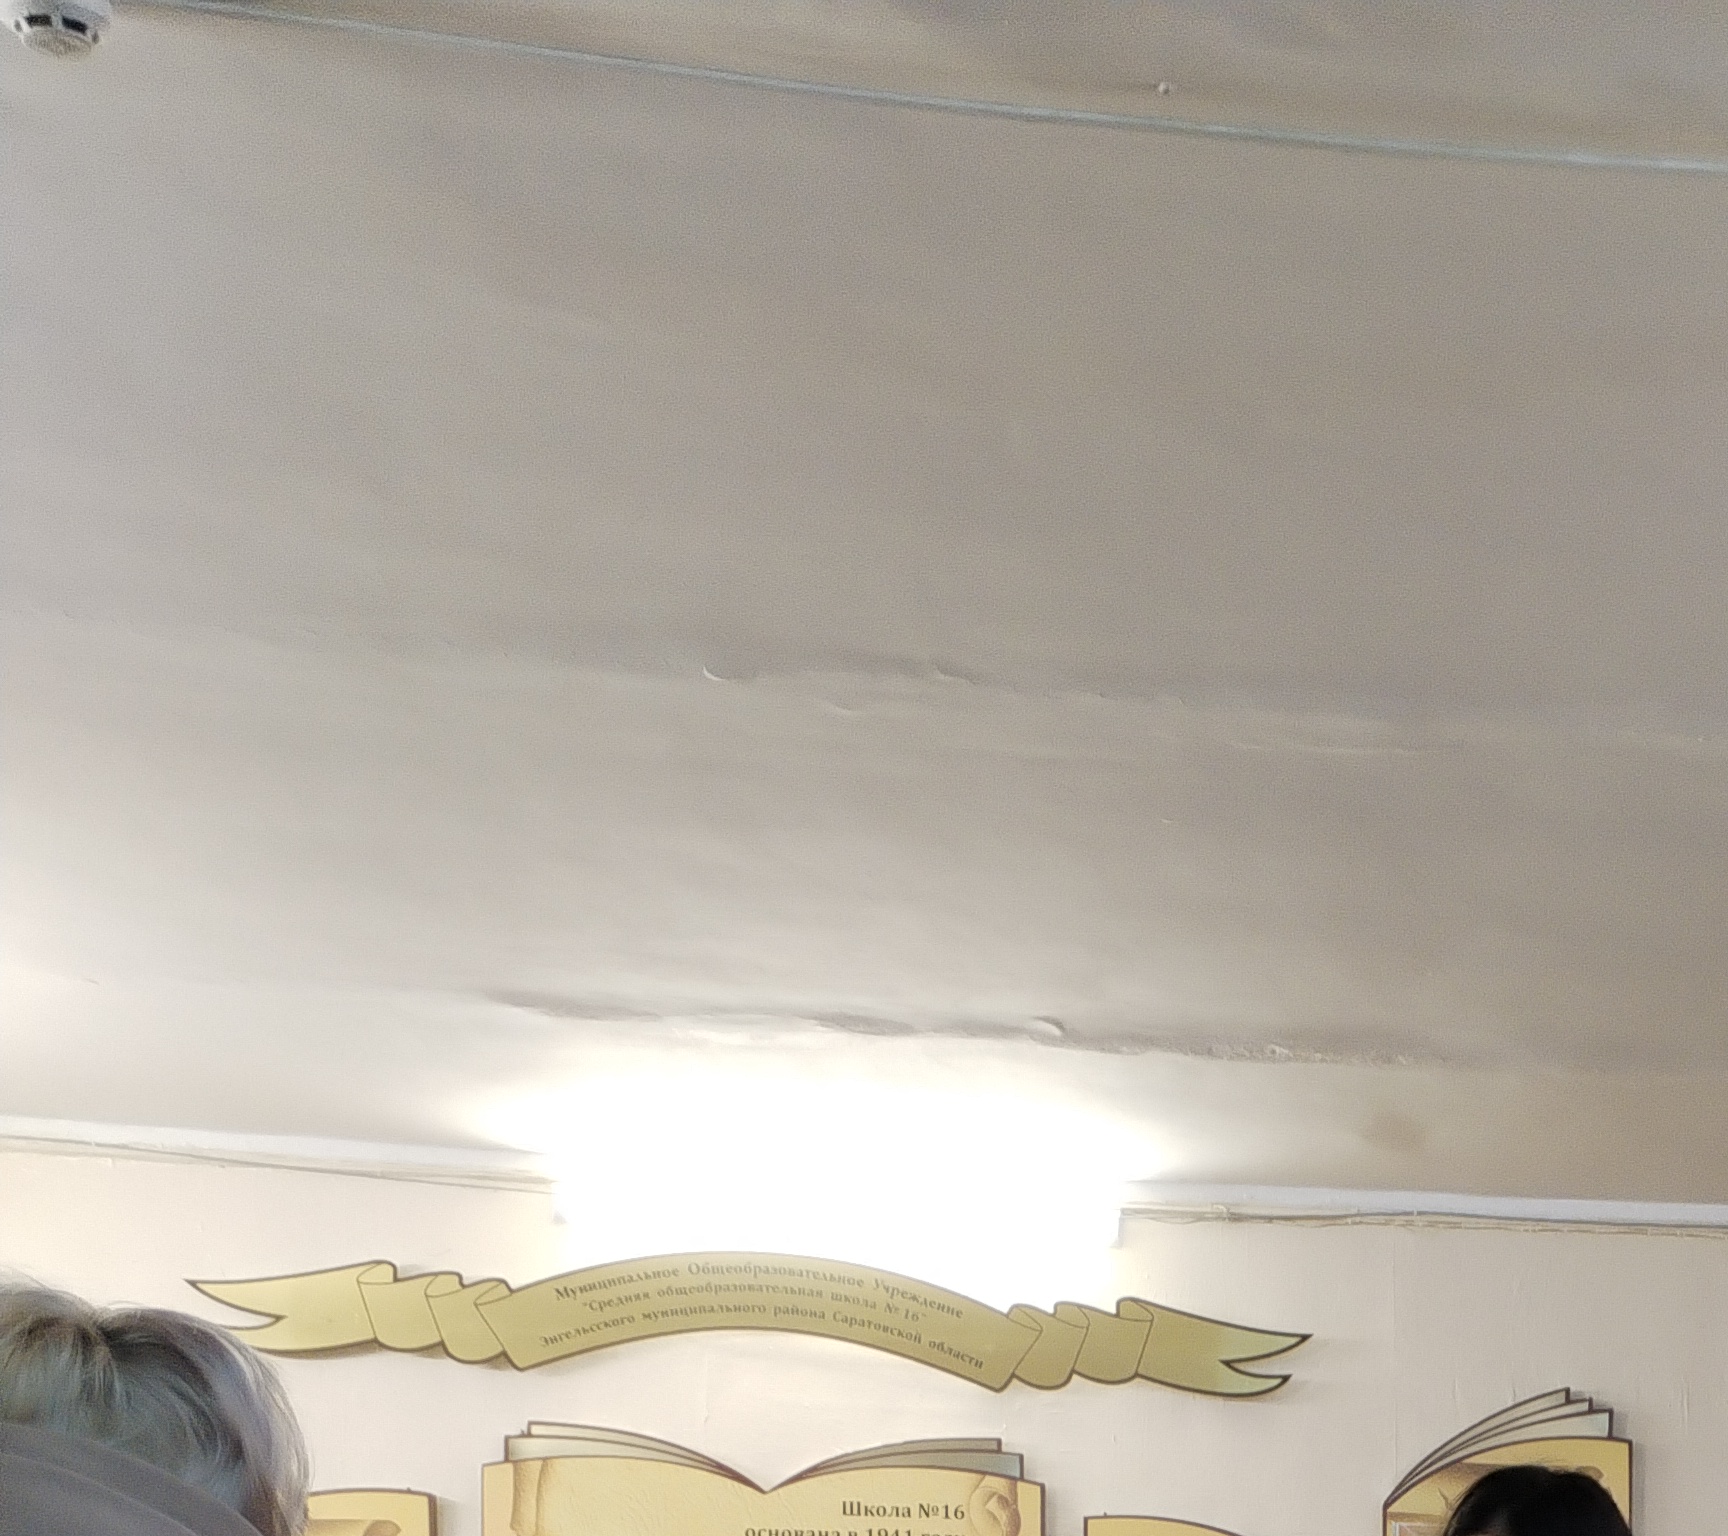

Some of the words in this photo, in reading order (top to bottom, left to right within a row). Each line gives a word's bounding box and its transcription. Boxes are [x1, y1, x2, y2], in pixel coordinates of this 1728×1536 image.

[554, 1267, 680, 1301] Муниципальное
[687, 1262, 865, 1288] Общеобразовательное
[873, 1278, 964, 1319] Учреждение
[657, 1282, 823, 1299] общеобразовательная
[831, 1291, 877, 1310] школа
[539, 1315, 635, 1347] Энгельсского
[641, 1302, 767, 1321] муниципального
[773, 1303, 826, 1320] района
[832, 1310, 922, 1344] Саратовской
[928, 1337, 984, 1369] области
[841, 1499, 912, 1519] Школа
[918, 1502, 966, 1520] №16
